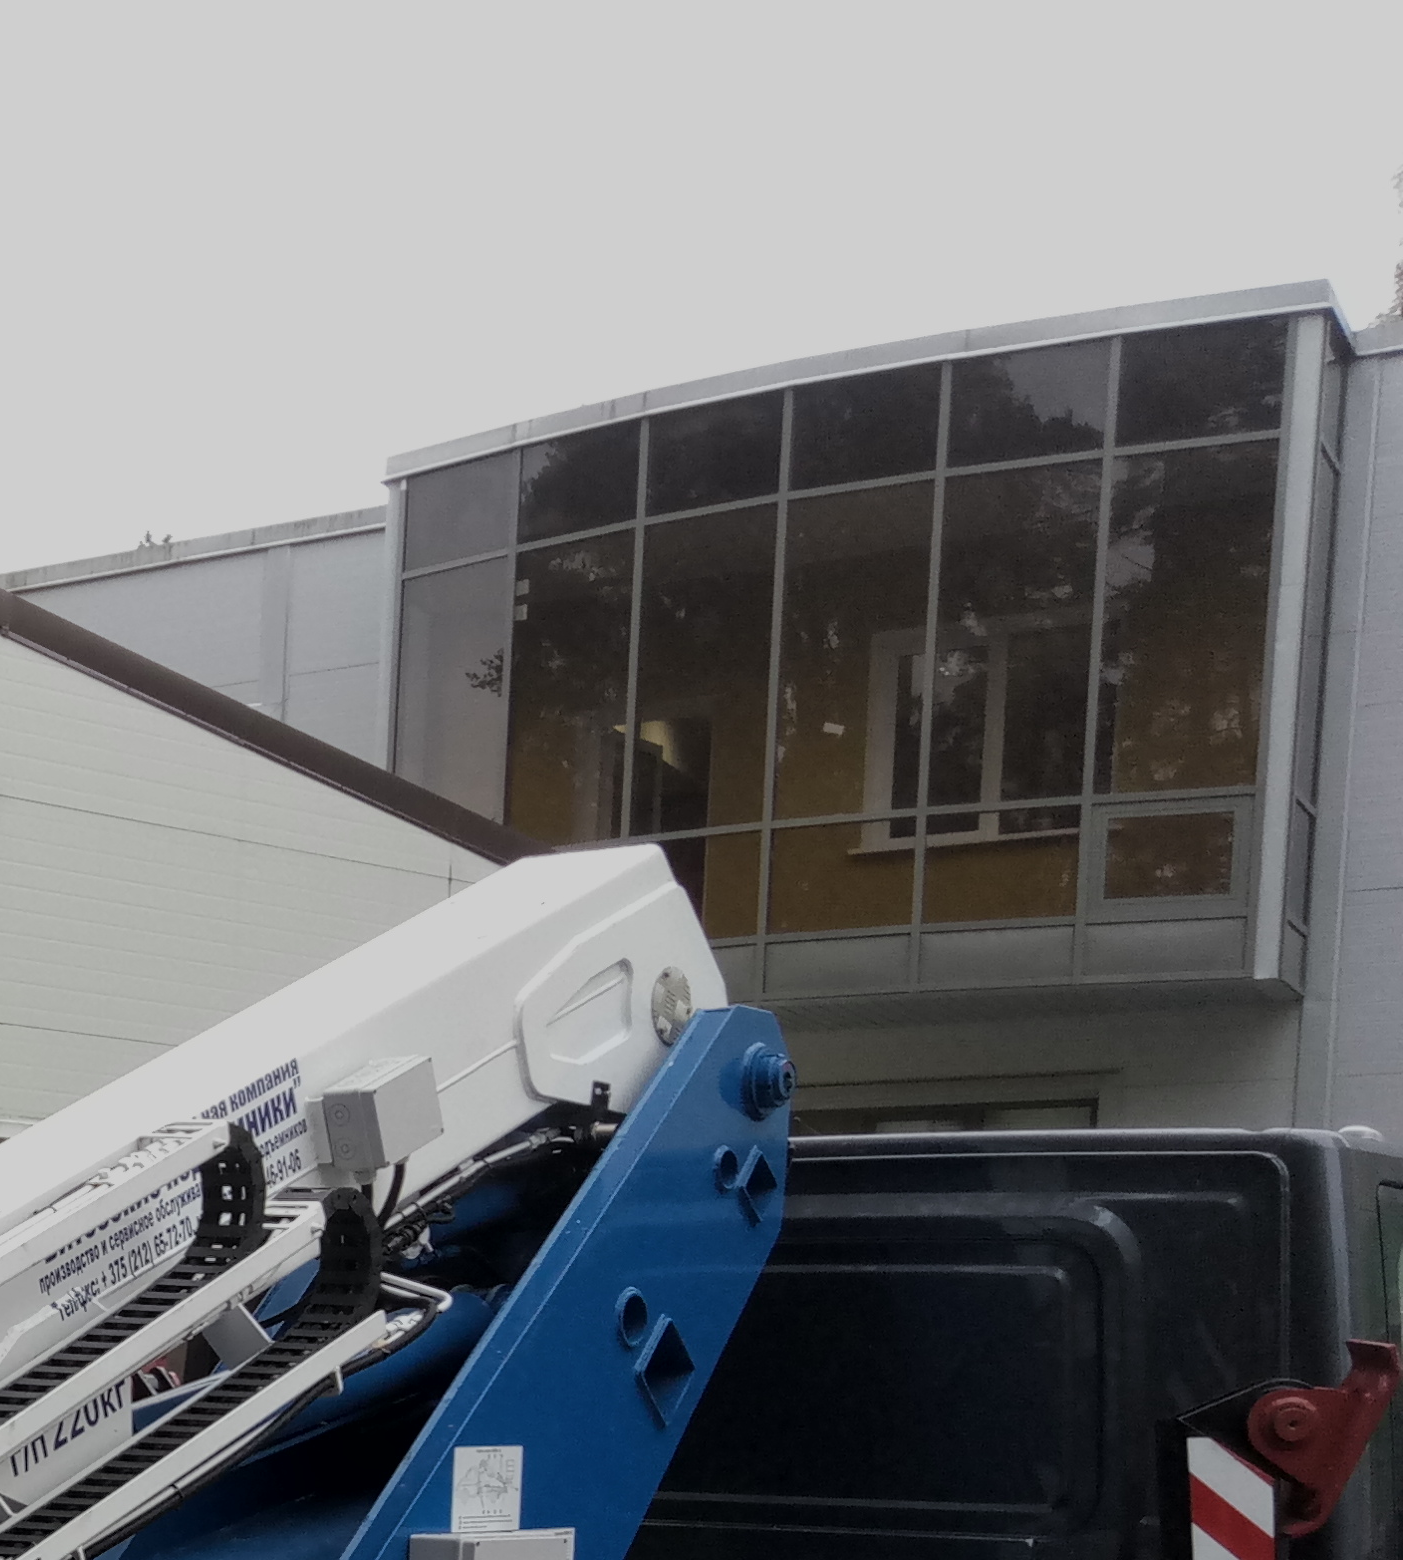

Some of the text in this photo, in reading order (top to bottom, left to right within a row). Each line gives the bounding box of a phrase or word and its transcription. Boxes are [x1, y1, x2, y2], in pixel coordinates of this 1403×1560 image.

[229, 1058, 299, 1112] компания
[38, 1244, 100, 1296] производство
[101, 1239, 108, 1256] и
[109, 1212, 155, 1250] сервисное
[108, 1256, 128, 1285] 375
[128, 1240, 156, 1279] (212)
